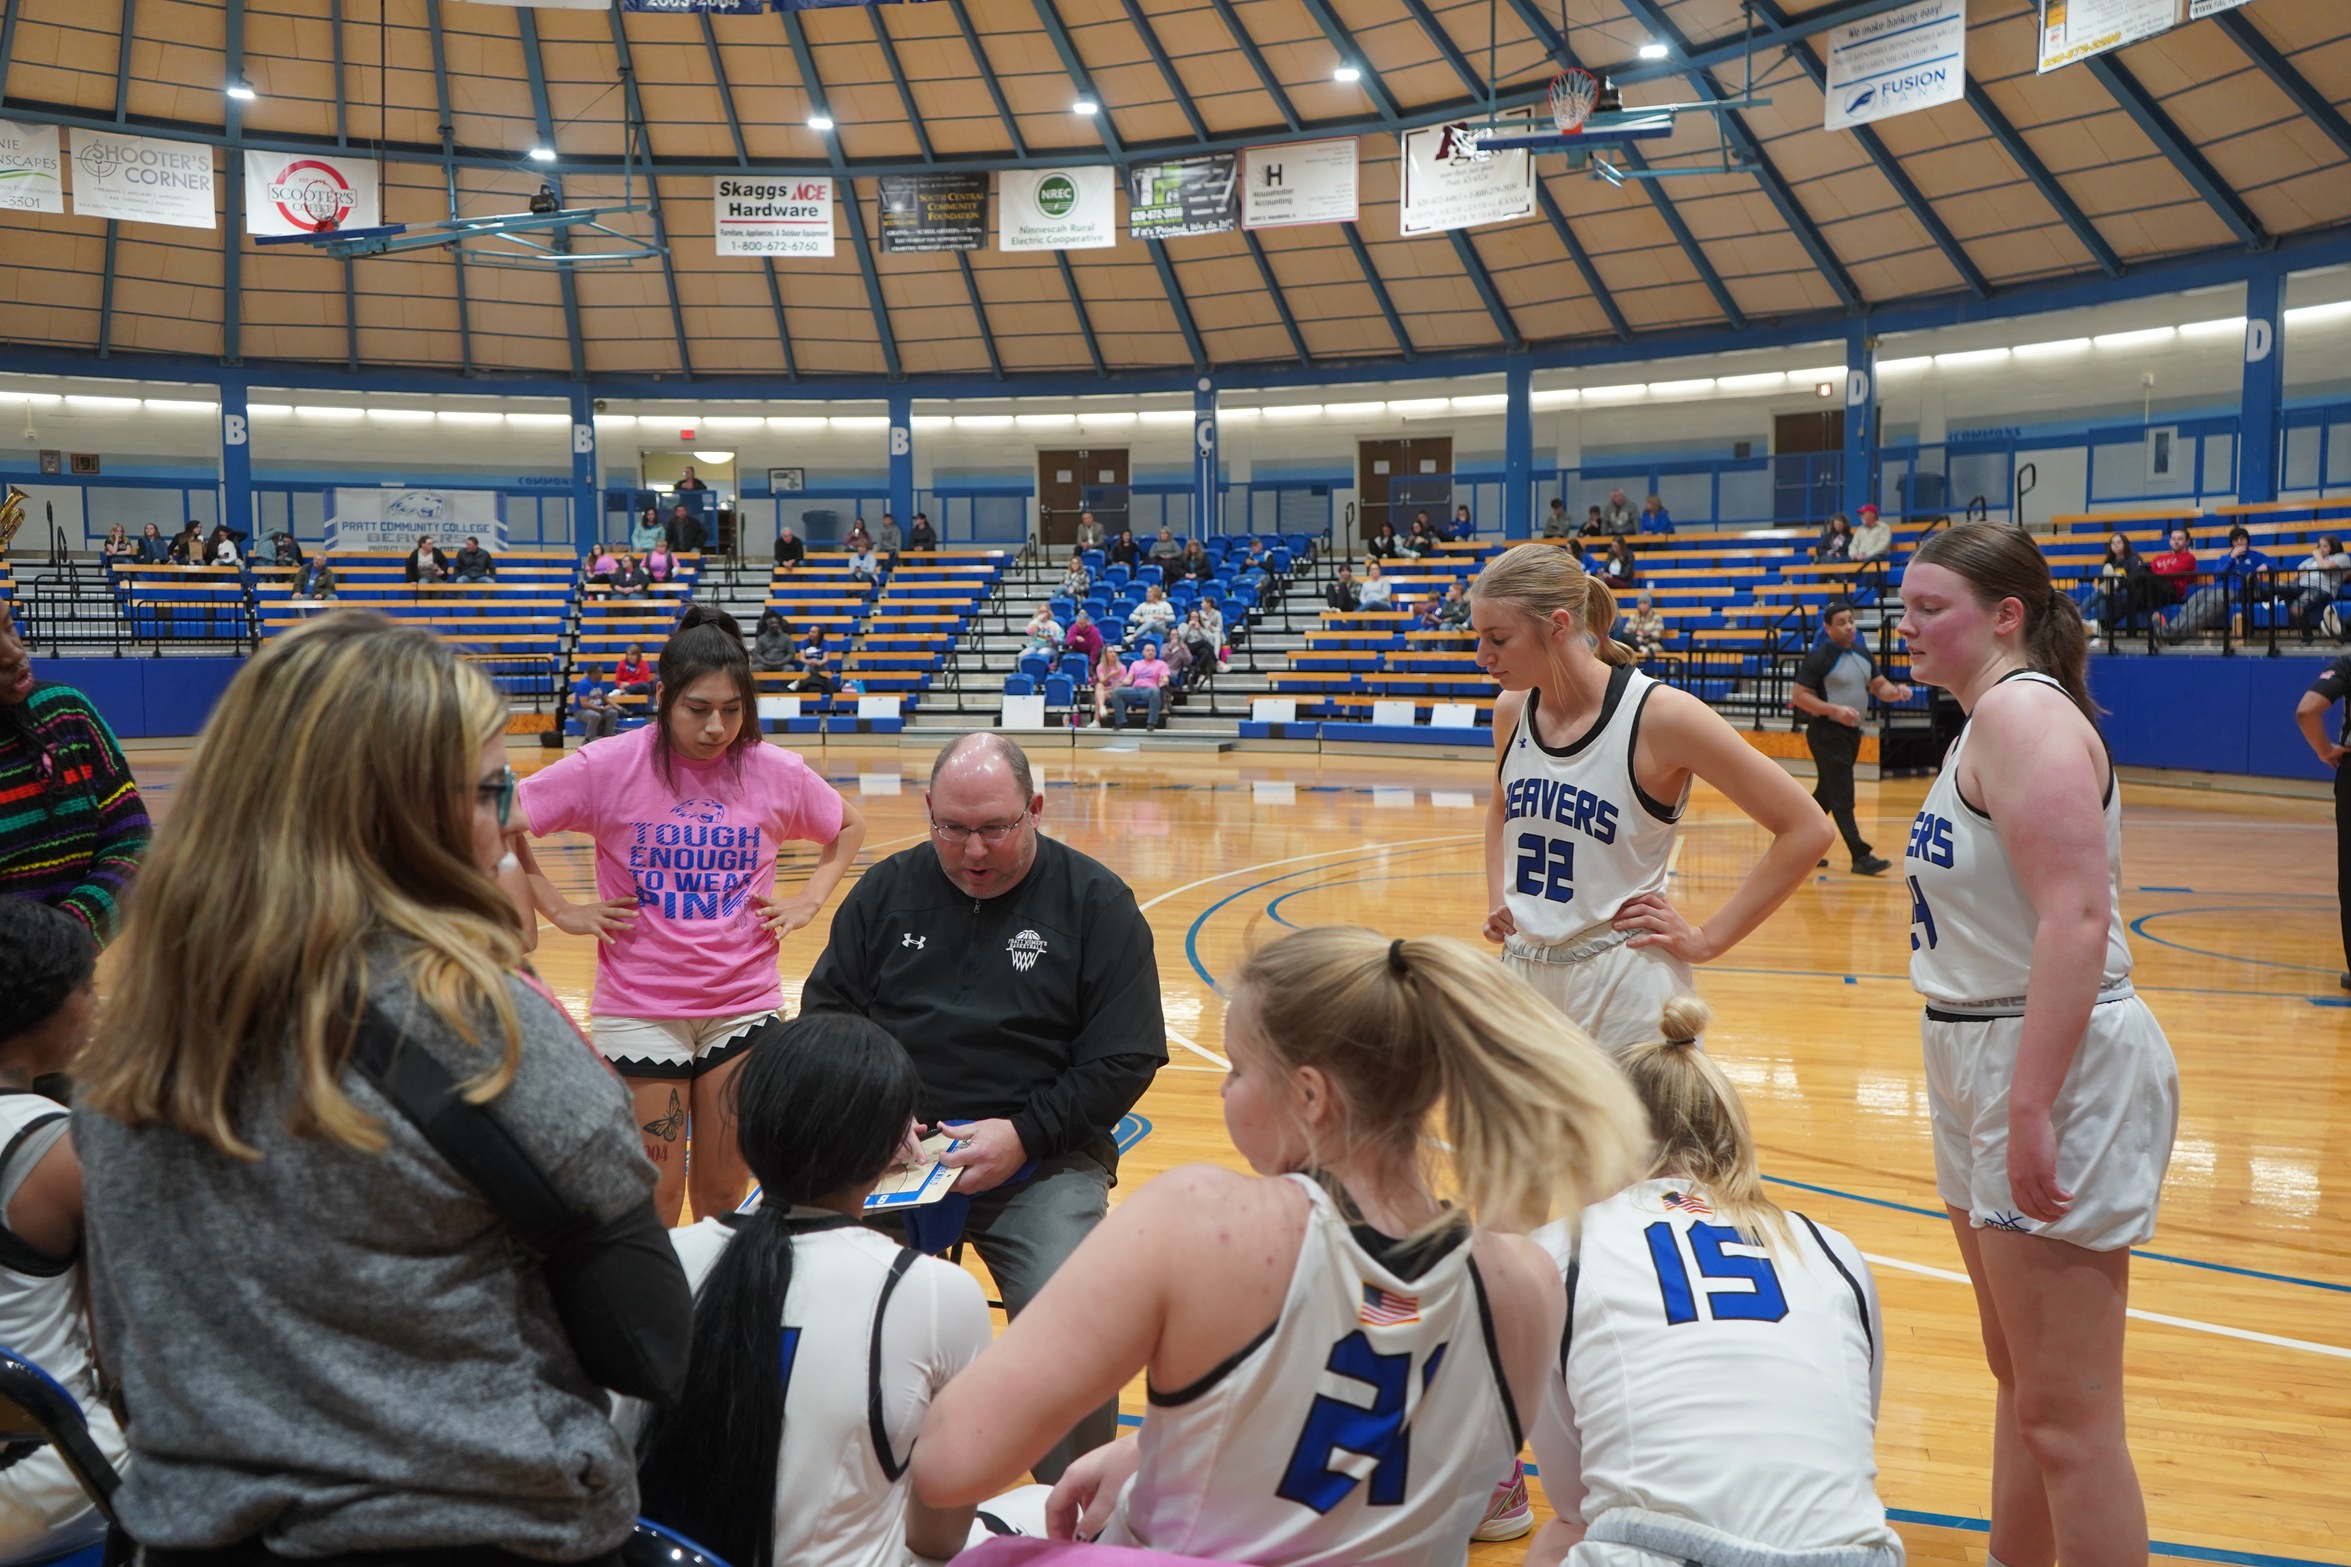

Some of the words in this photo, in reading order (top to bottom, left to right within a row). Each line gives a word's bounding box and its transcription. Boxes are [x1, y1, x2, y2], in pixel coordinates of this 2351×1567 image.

[1862, 21, 1884, 36] make
[1886, 10, 1918, 29] banking
[1881, 68, 1946, 97] FUSION
[1882, 82, 1945, 107] BANK
[92, 142, 210, 172] SHOOTER'S
[125, 167, 210, 191] CORNER
[1265, 163, 1282, 187] H
[271, 186, 354, 205] SCOOTER'S
[719, 180, 787, 200] Skaggs
[790, 182, 827, 201] ACE
[1041, 187, 1072, 199] NREC
[1254, 198, 1293, 207] Accounting
[729, 202, 818, 217] Hardware
[1070, 223, 1095, 232] Rural
[731, 240, 819, 252] 1-800-672-6760
[1011, 237, 1044, 246] Electric
[1046, 235, 1103, 244] Cooperative
[2246, 318, 2272, 362] D
[1848, 370, 1869, 406] D
[225, 414, 247, 445] B
[574, 424, 594, 453] B
[890, 426, 910, 456] B
[1197, 420, 1214, 449] C
[342, 521, 376, 531] PRATT
[380, 521, 439, 532] COMMUNITY
[442, 523, 490, 534] COLLEGE
[629, 822, 761, 848] TOUGH
[630, 845, 758, 870] ENOUGH
[1516, 832, 1575, 904] 22
[628, 868, 664, 891] TO
[635, 885, 745, 920] PINK
[1644, 1219, 1790, 1326] 15
